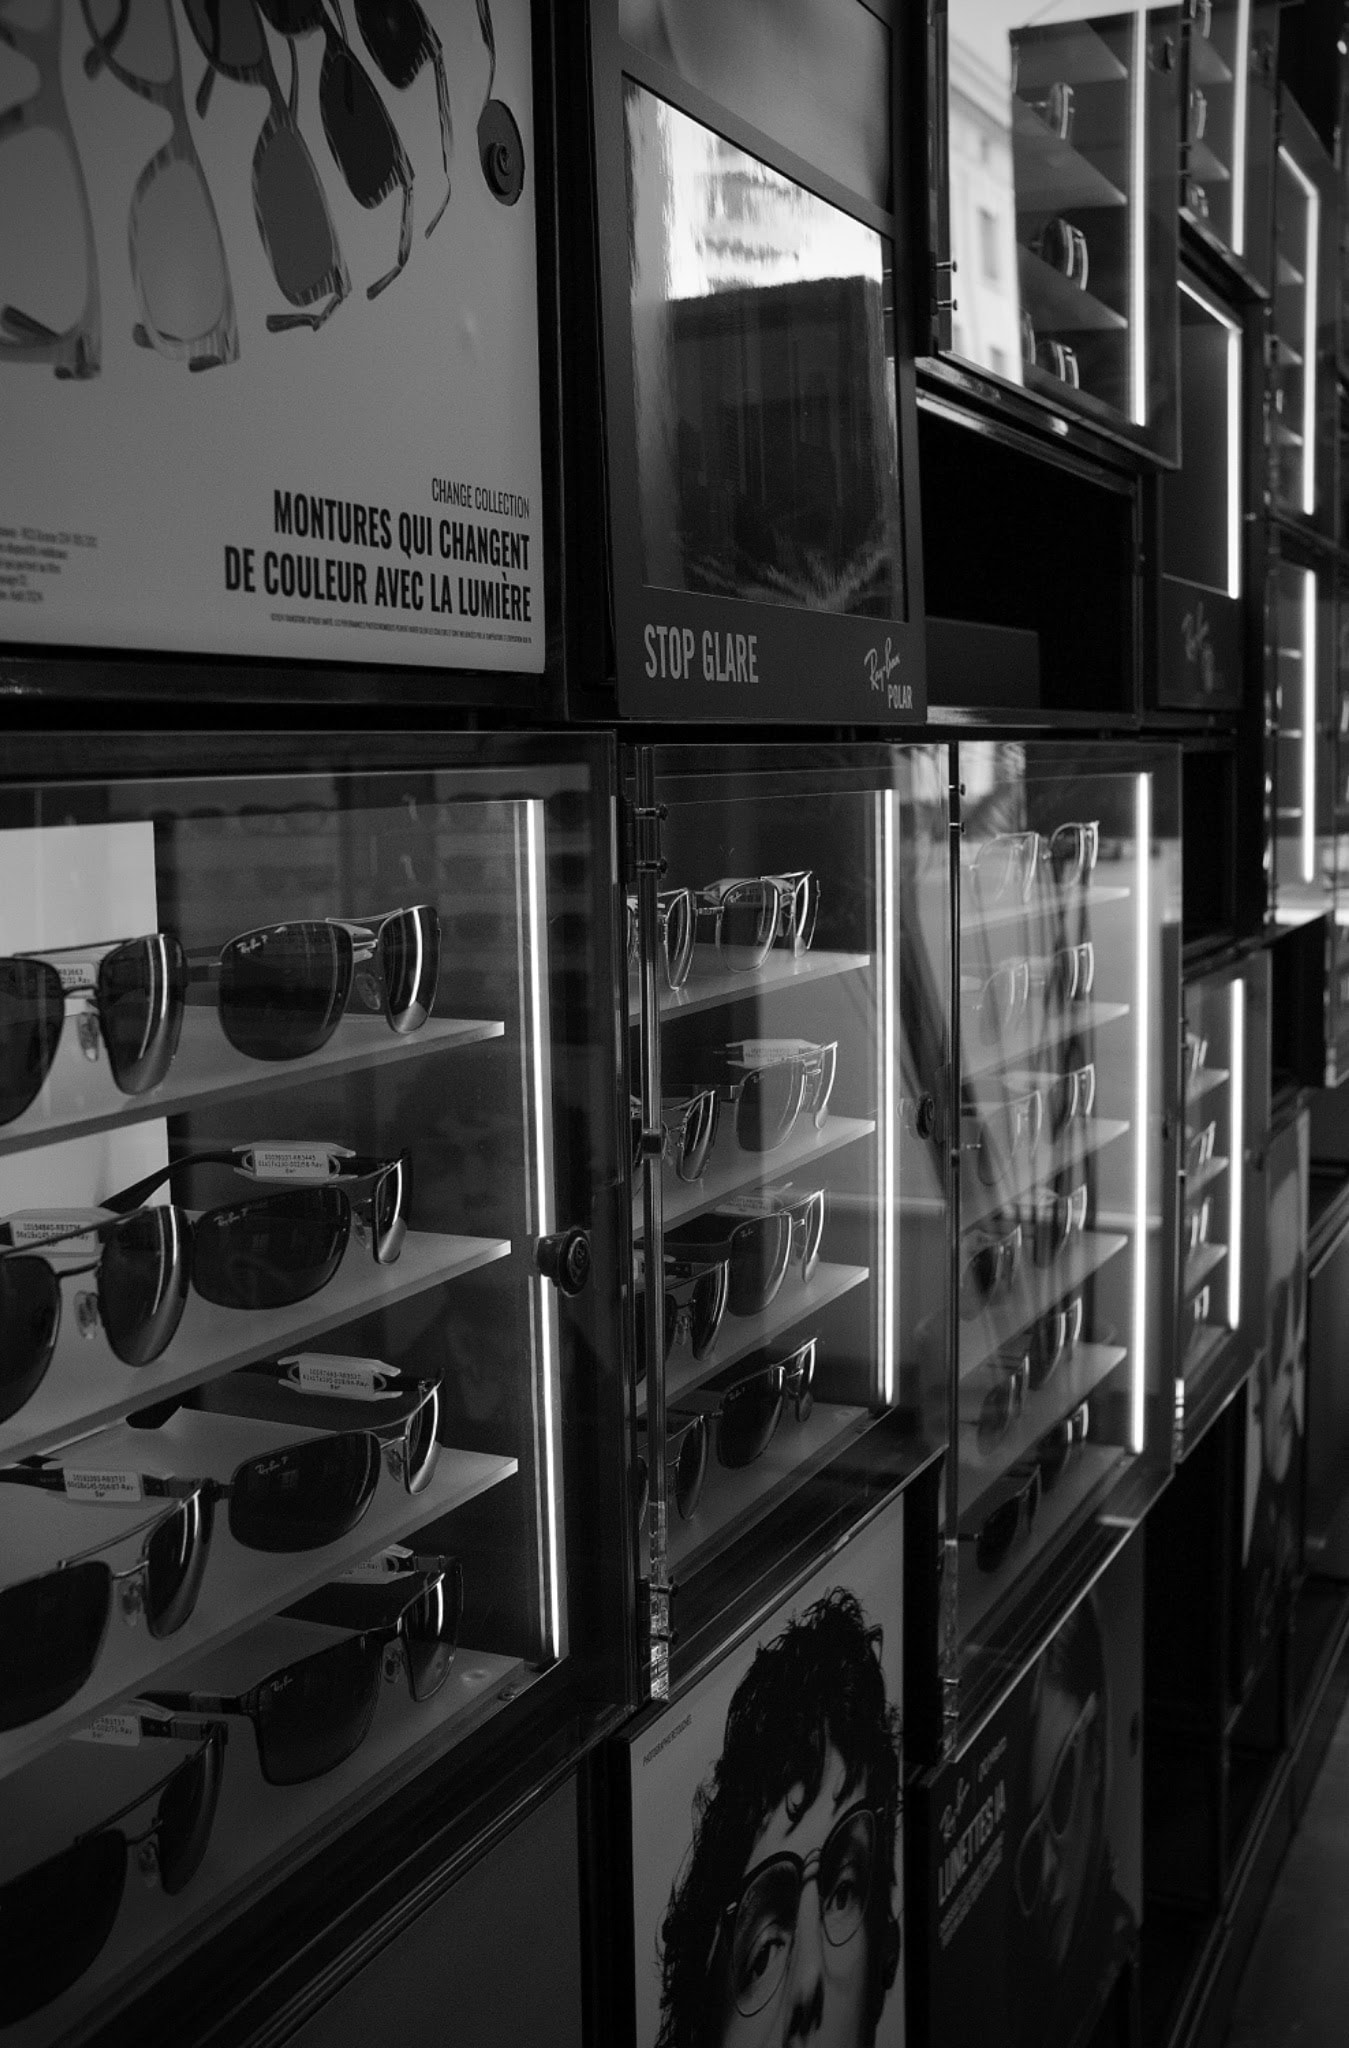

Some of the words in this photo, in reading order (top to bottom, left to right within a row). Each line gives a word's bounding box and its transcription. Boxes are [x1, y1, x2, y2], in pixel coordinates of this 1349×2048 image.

[432, 478, 472, 508] CHANGE
[474, 486, 530, 519] COLLECTION
[274, 489, 392, 549] MONTURES
[399, 512, 433, 559] QUI
[439, 520, 530, 571] CHANGENT
[225, 545, 255, 592] DE
[264, 551, 367, 604] COULEUR
[375, 566, 424, 611] AVEC
[430, 573, 453, 614] LA
[458, 572, 532, 622] LUMIÈRE
[644, 623, 696, 681] STOP
[702, 630, 760, 684] GLARE
[888, 684, 913, 710] POLAR
